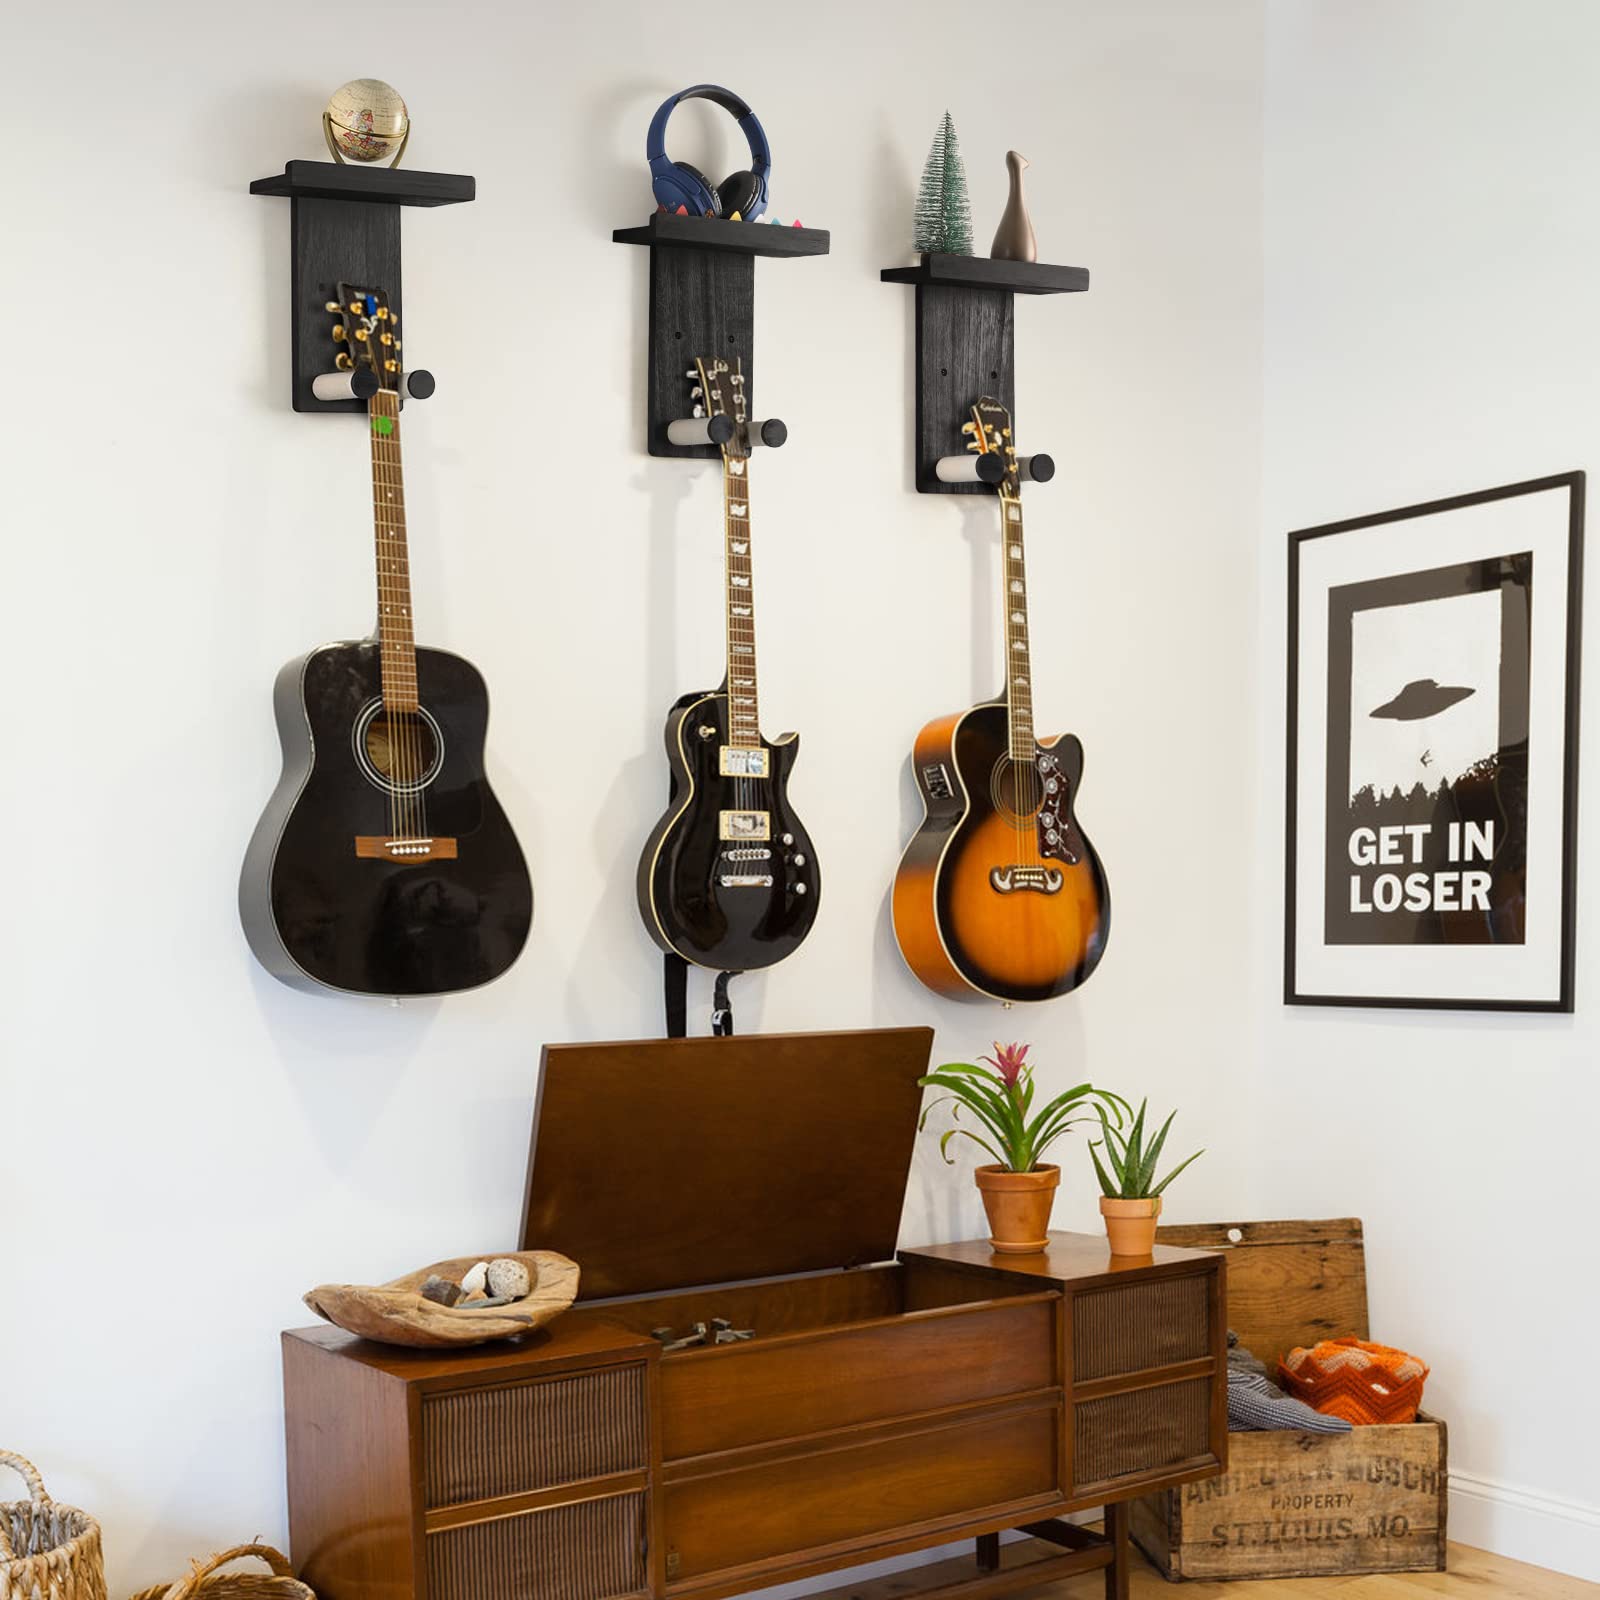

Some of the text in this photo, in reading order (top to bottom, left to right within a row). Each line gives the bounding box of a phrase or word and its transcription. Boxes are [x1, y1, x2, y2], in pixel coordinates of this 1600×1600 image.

[1349, 820, 1495, 866] GET IN
[1350, 870, 1493, 913] LOSER
[1271, 1493, 1354, 1511] PROPERTY
[1367, 1514, 1413, 1540] MO.
